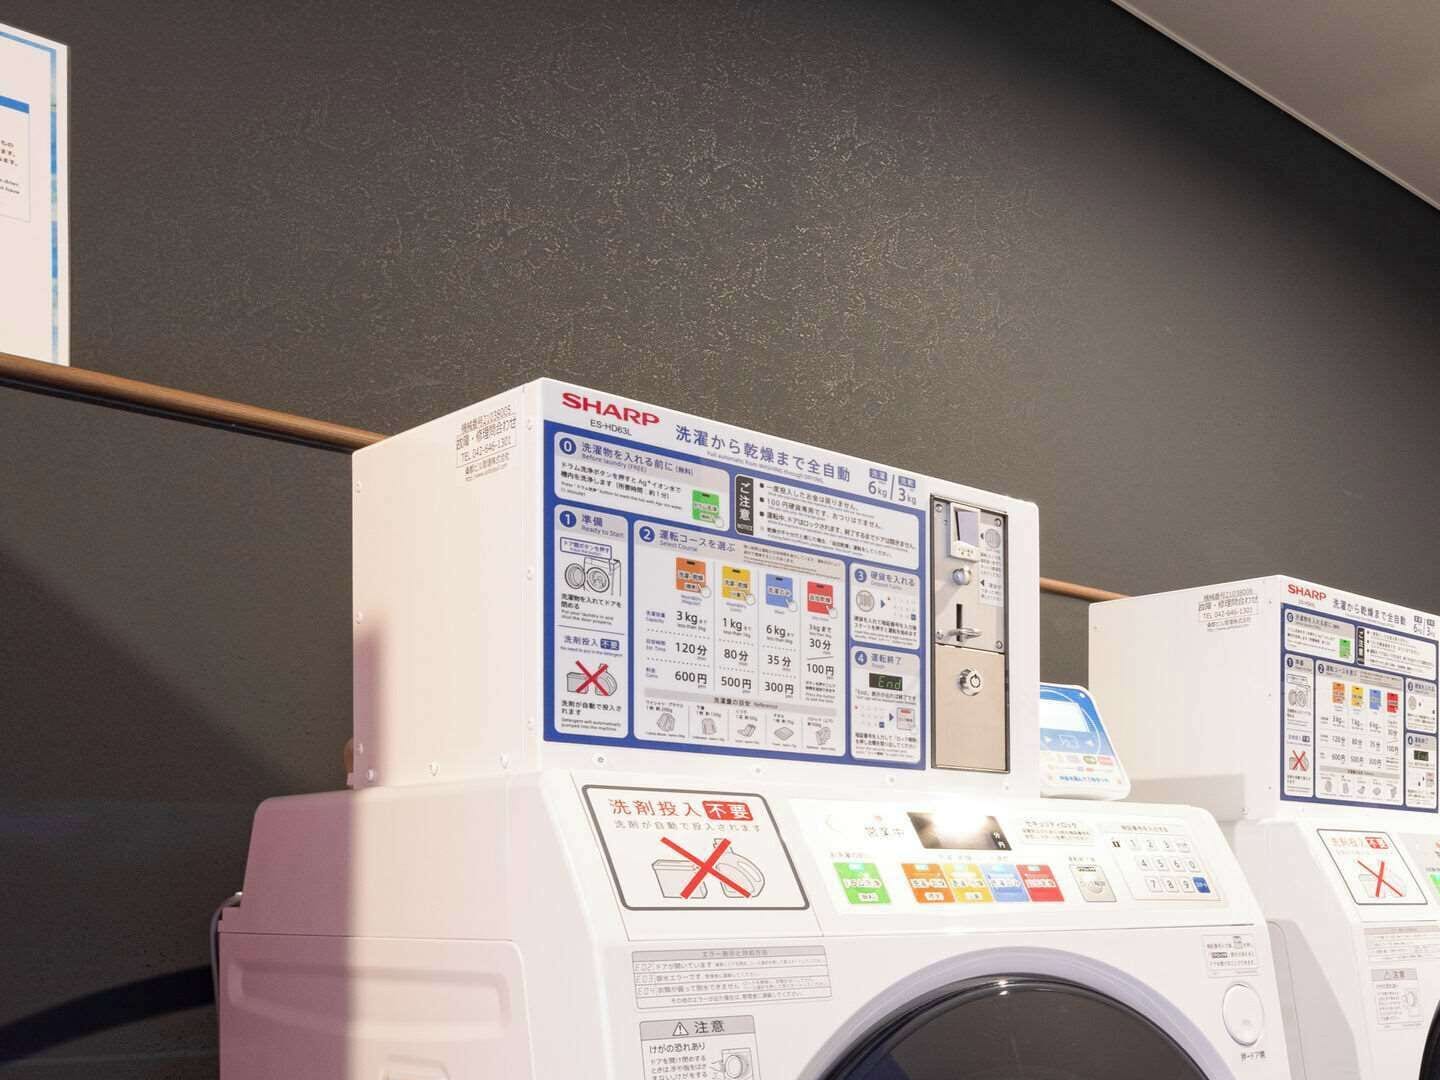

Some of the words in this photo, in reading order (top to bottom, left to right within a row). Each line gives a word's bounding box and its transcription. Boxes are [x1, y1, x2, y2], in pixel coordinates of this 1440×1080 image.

[562, 392, 660, 426] SHARP
[590, 418, 633, 437] ES-HD63L
[582, 442, 673, 471] 洗濯物を入れる前に
[675, 423, 850, 483] 洗濯から乾燥まで全自動
[565, 513, 571, 525] 1
[582, 513, 603, 528] 準備
[643, 527, 651, 541] 2
[660, 529, 735, 552] 運転コースを選ぶ
[1288, 584, 1327, 601] SHARP
[1333, 598, 1407, 626] 洗濯から乾燥まで全自動
[563, 635, 598, 647] 洗剤投入
[809, 638, 831, 651] 30分
[676, 642, 707, 656] 120分
[724, 648, 749, 662] 80分
[768, 654, 792, 668] 35分
[807, 663, 834, 677] 100円
[675, 671, 707, 685] 600円
[721, 676, 752, 690] 500円
[765, 681, 794, 695] 300円
[608, 799, 701, 817] 洗剤投入
[708, 803, 751, 819] 不要
[614, 820, 760, 833] 洗剤が自動で投入されます
[694, 1019, 725, 1034] 注意
[649, 1042, 706, 1054] けがの恐れあり
